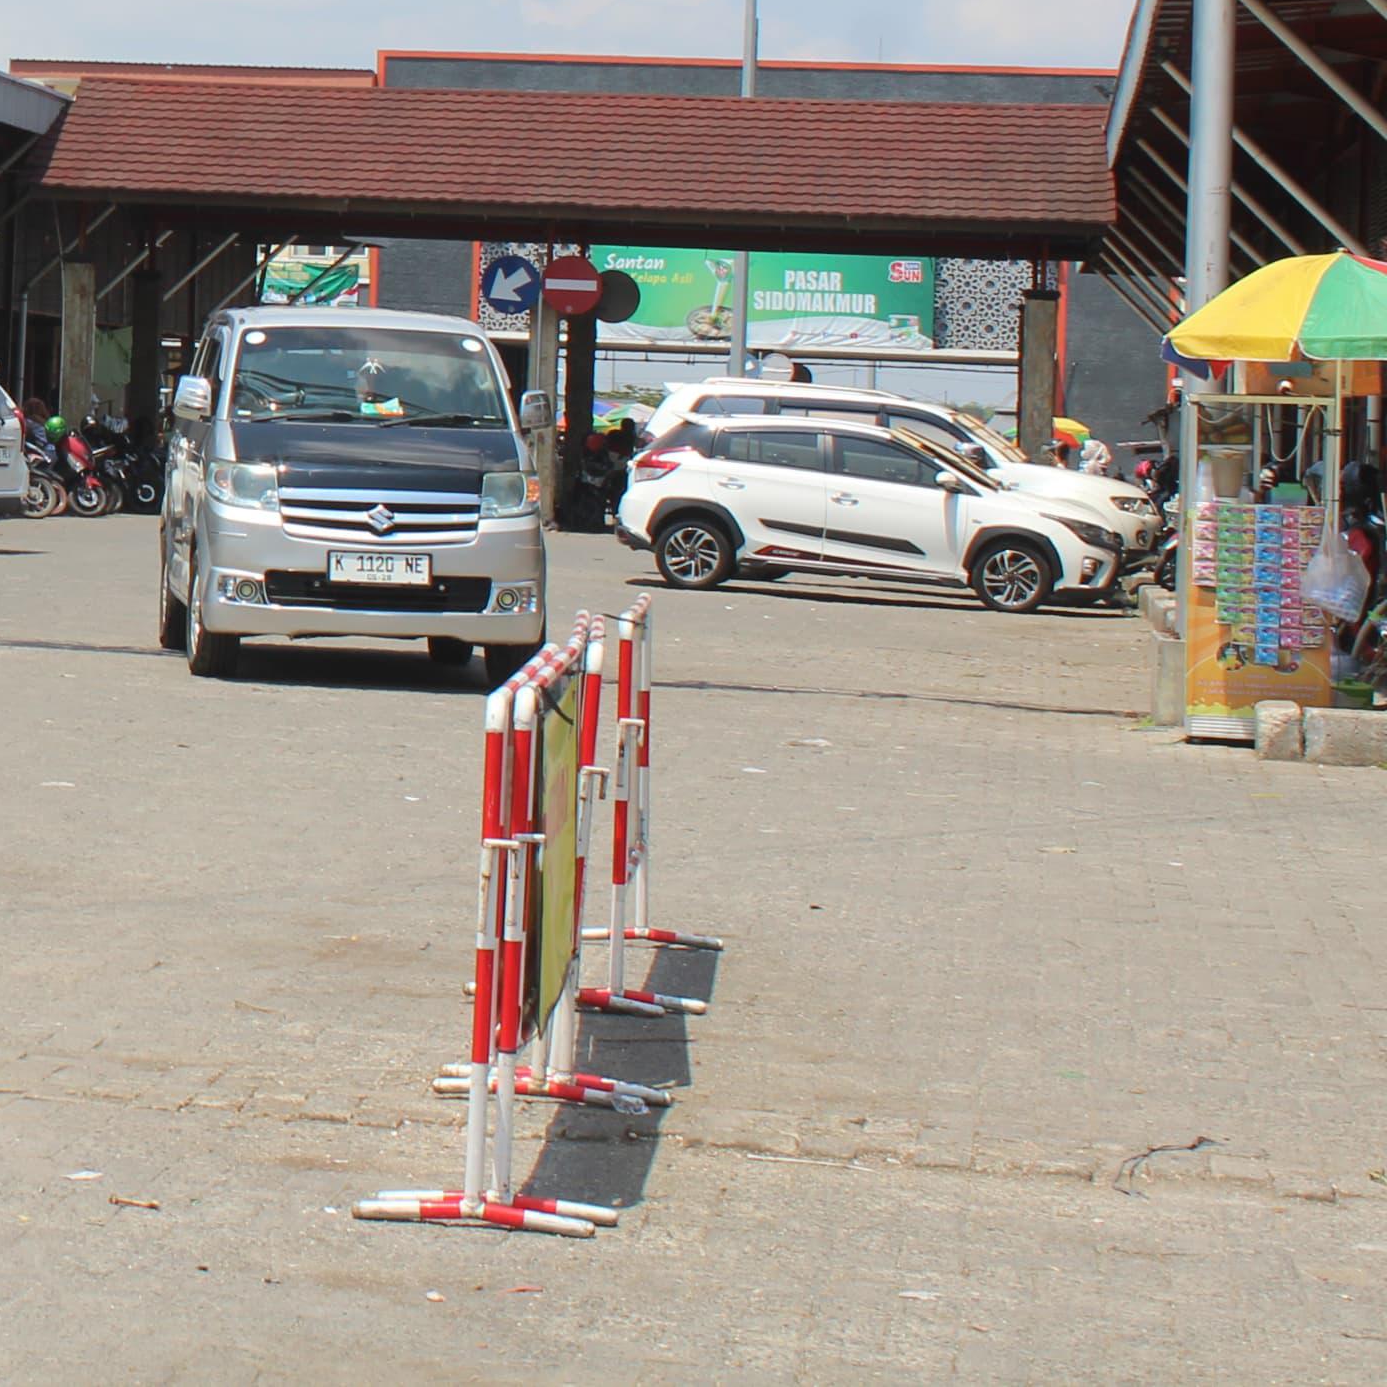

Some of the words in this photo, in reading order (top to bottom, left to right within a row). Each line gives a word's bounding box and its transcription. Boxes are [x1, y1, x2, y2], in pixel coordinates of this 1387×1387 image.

[604, 253, 665, 271] Santan
[784, 269, 842, 291] PASAR
[753, 290, 877, 314] SIDOMAKMUR
[335, 555, 344, 571] K
[356, 555, 394, 572] 1120
[405, 557, 424, 573] NE
